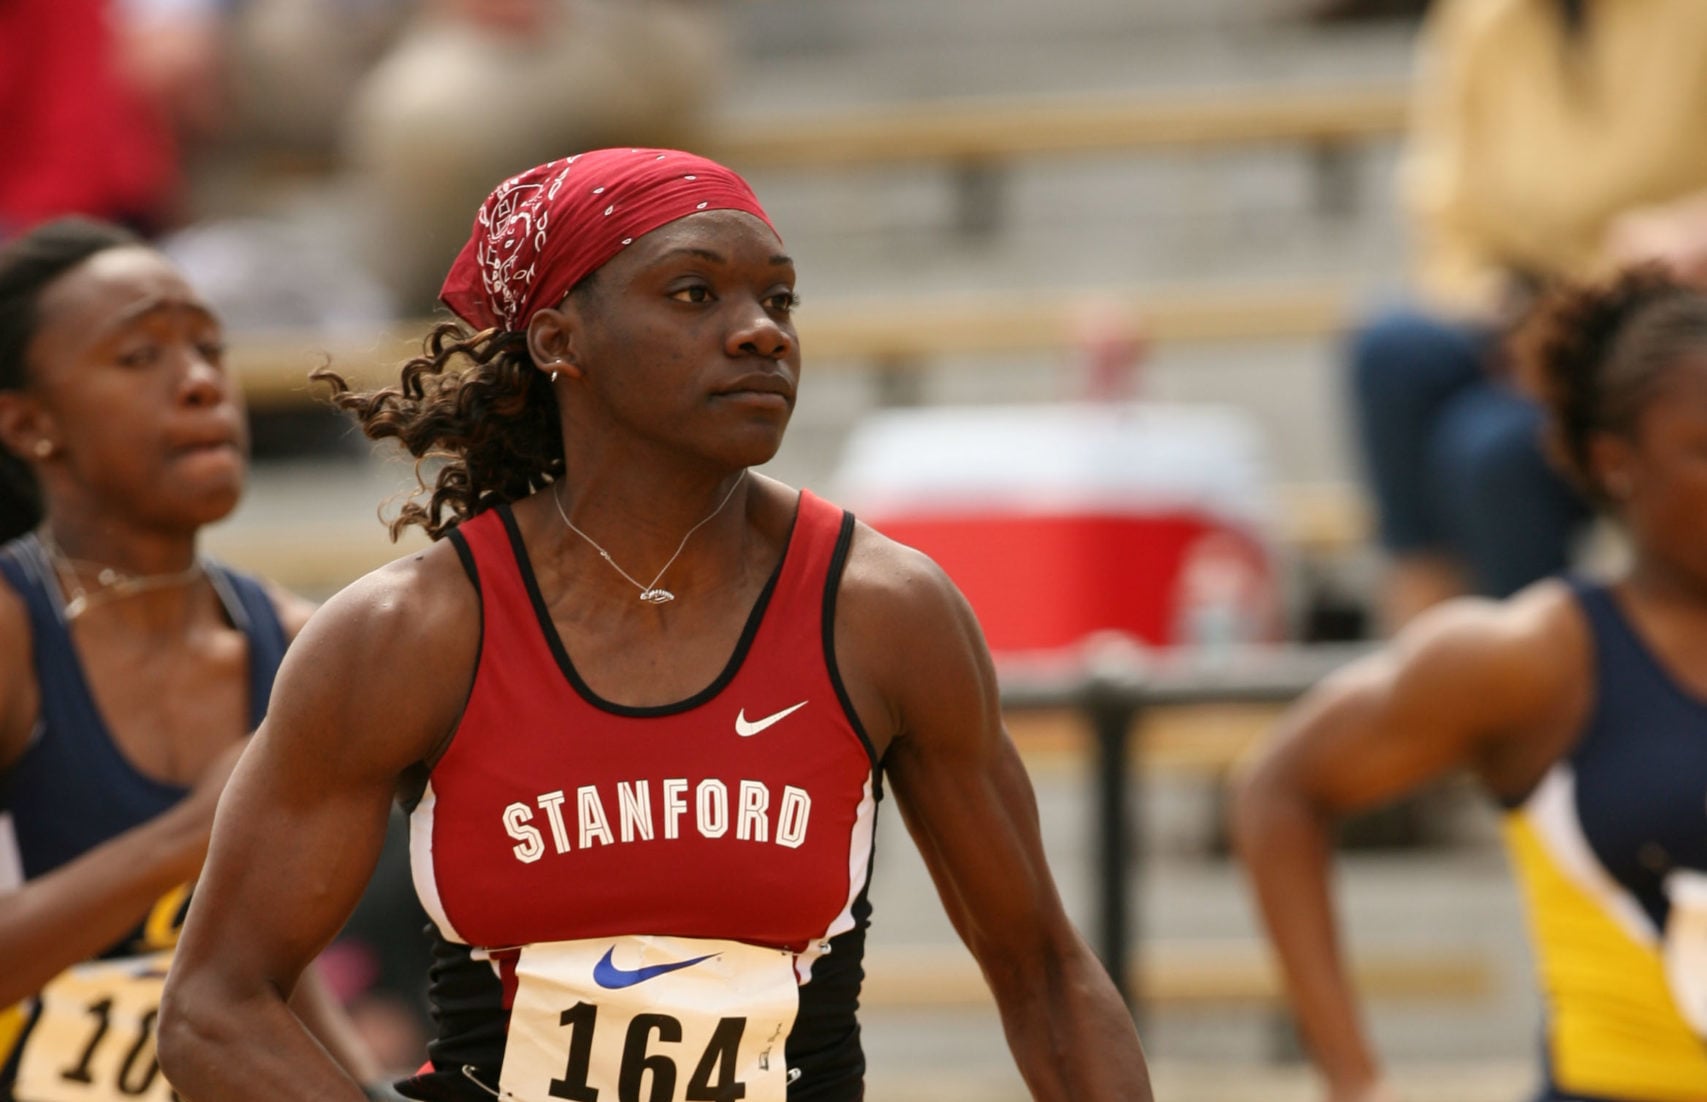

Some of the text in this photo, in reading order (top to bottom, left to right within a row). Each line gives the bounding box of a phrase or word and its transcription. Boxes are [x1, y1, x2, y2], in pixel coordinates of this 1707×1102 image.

[502, 778, 811, 864] STANFORD
[60, 996, 179, 1102] 10
[548, 1000, 748, 1102] 164
